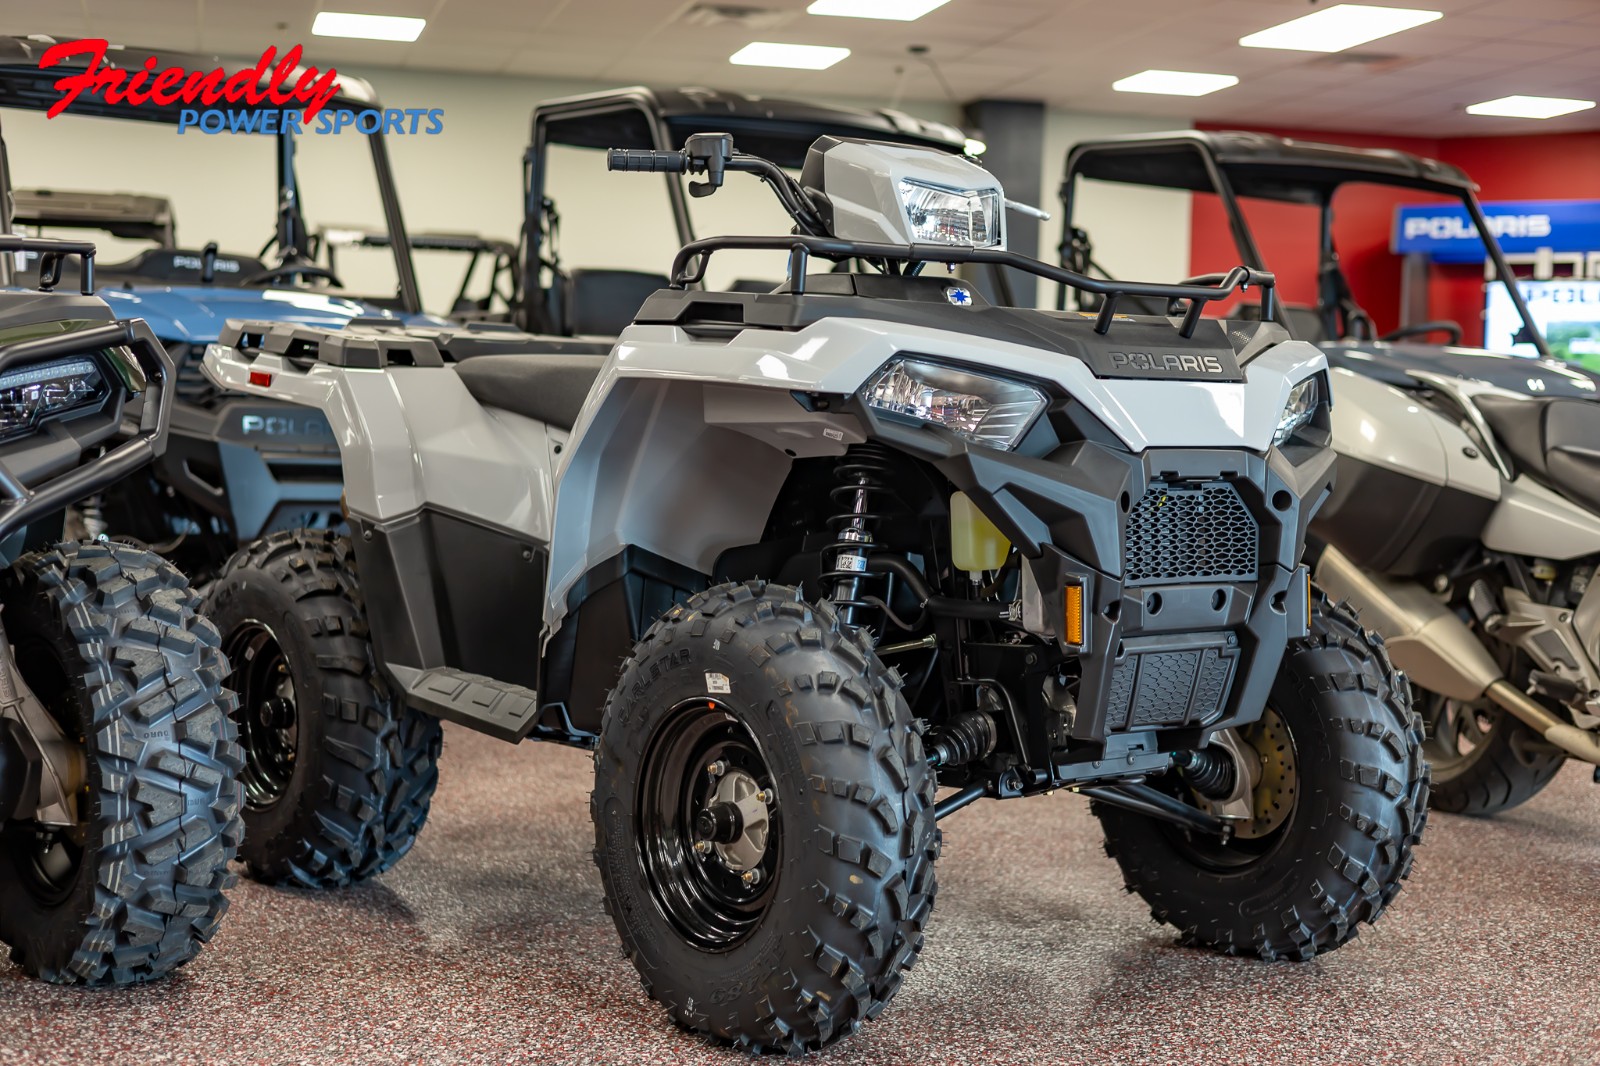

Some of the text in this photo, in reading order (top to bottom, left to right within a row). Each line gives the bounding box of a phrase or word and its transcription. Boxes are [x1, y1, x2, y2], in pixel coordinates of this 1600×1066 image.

[173, 255, 240, 273] POLRIS
[1526, 288, 1600, 303] POL
[1107, 351, 1223, 373] POLARIS
